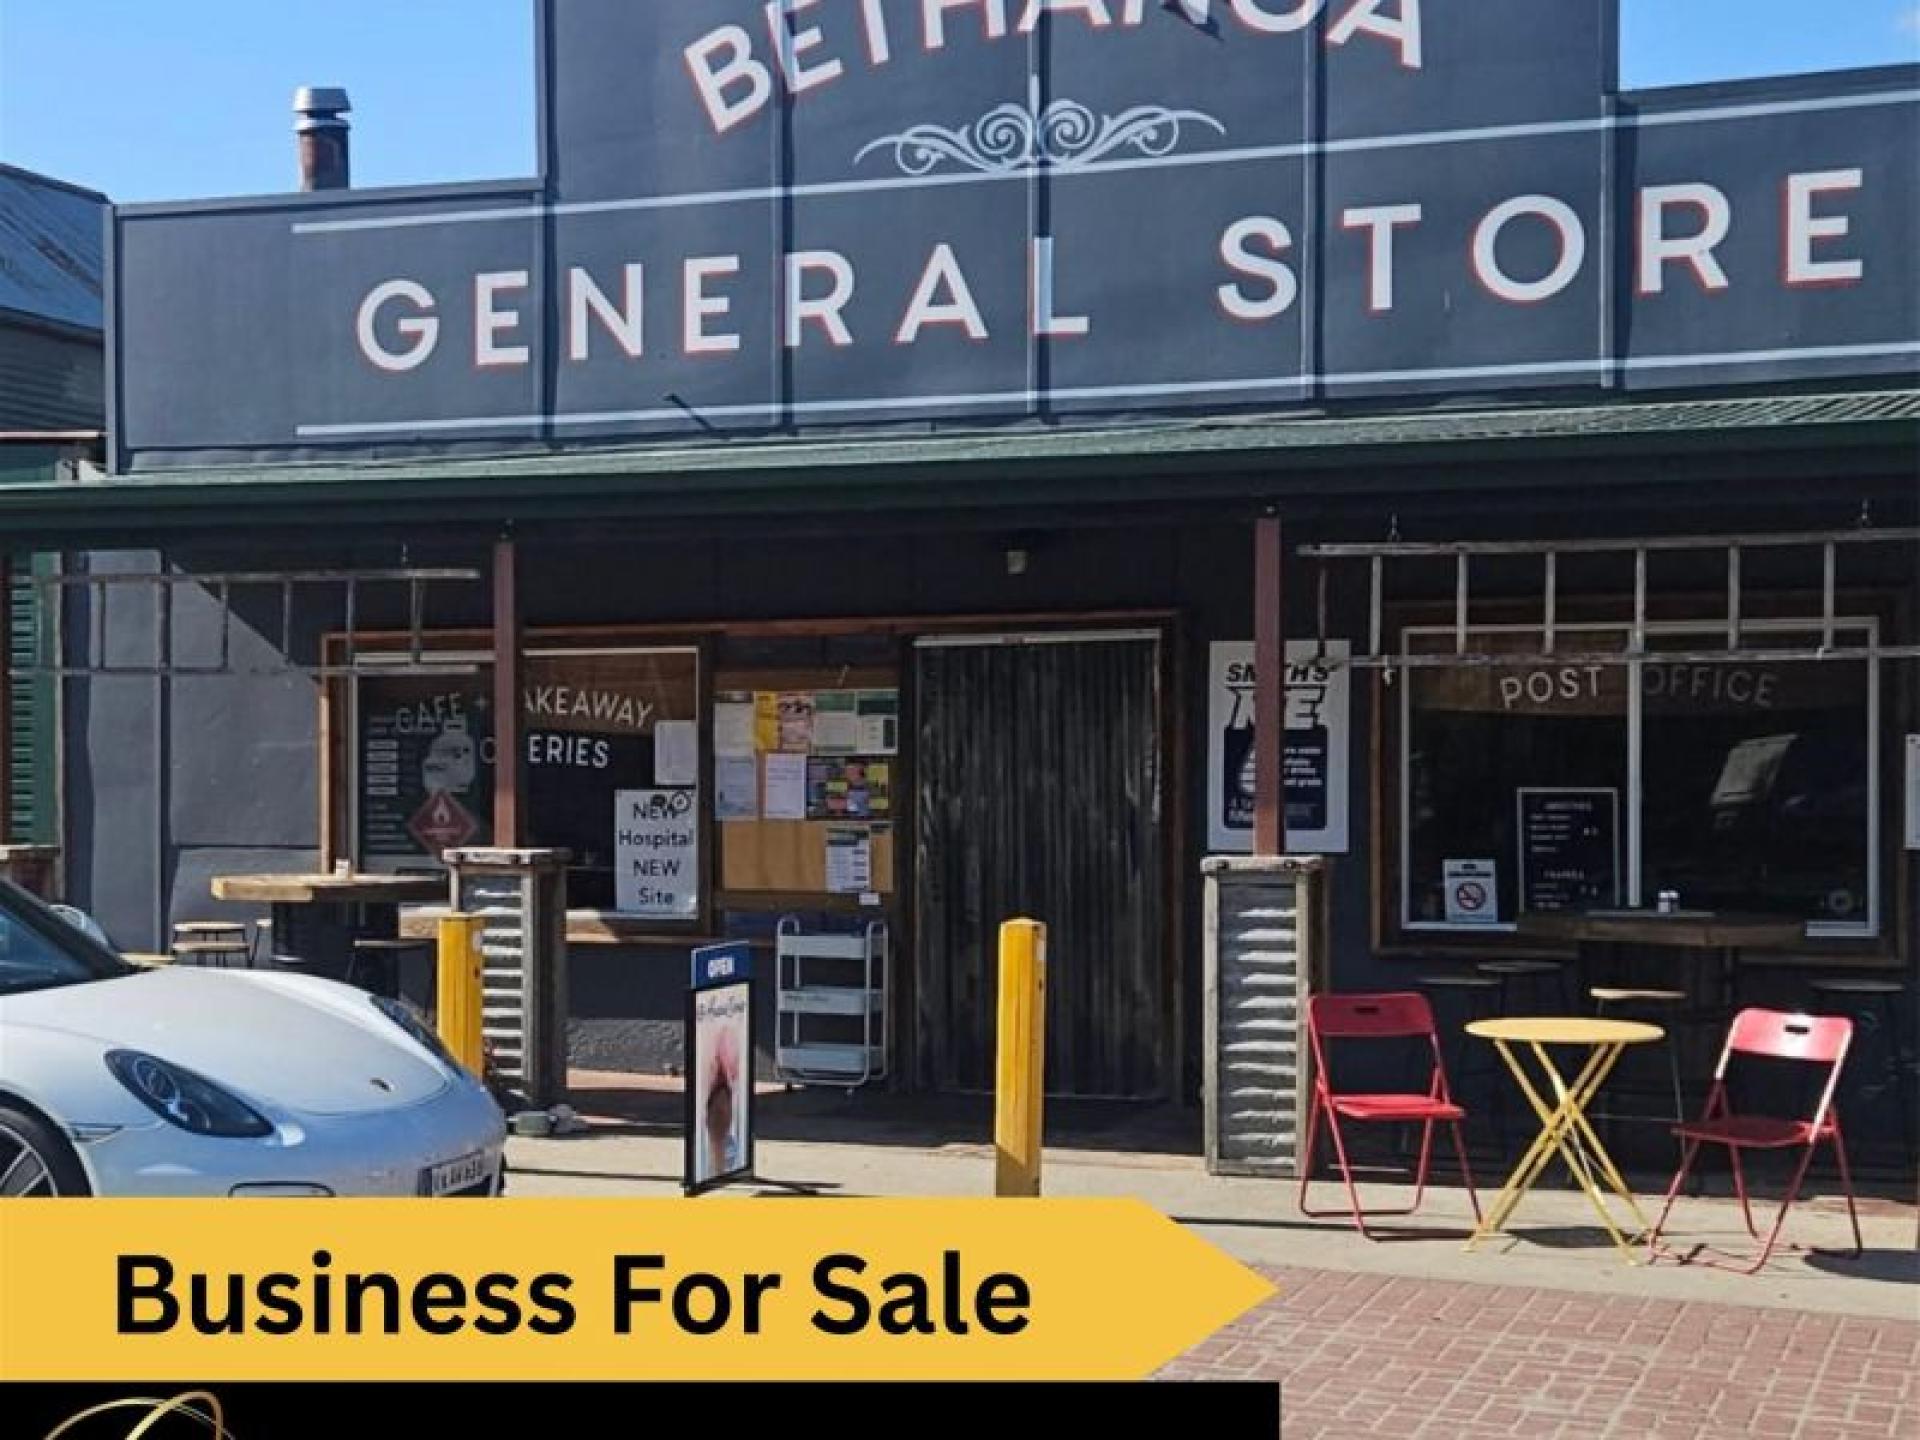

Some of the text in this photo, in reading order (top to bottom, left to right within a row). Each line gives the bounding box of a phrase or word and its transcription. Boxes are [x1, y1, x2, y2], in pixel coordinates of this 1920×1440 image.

[682, 0, 1422, 134] BETHA
[355, 167, 1864, 371] GENERAL STORE
[1500, 663, 1779, 710] POST OFFICE
[523, 686, 655, 729] AKEAWAY
[632, 802, 681, 820] NEW
[618, 828, 694, 851] Hospital
[632, 857, 682, 877] NEW
[637, 886, 675, 906] Site
